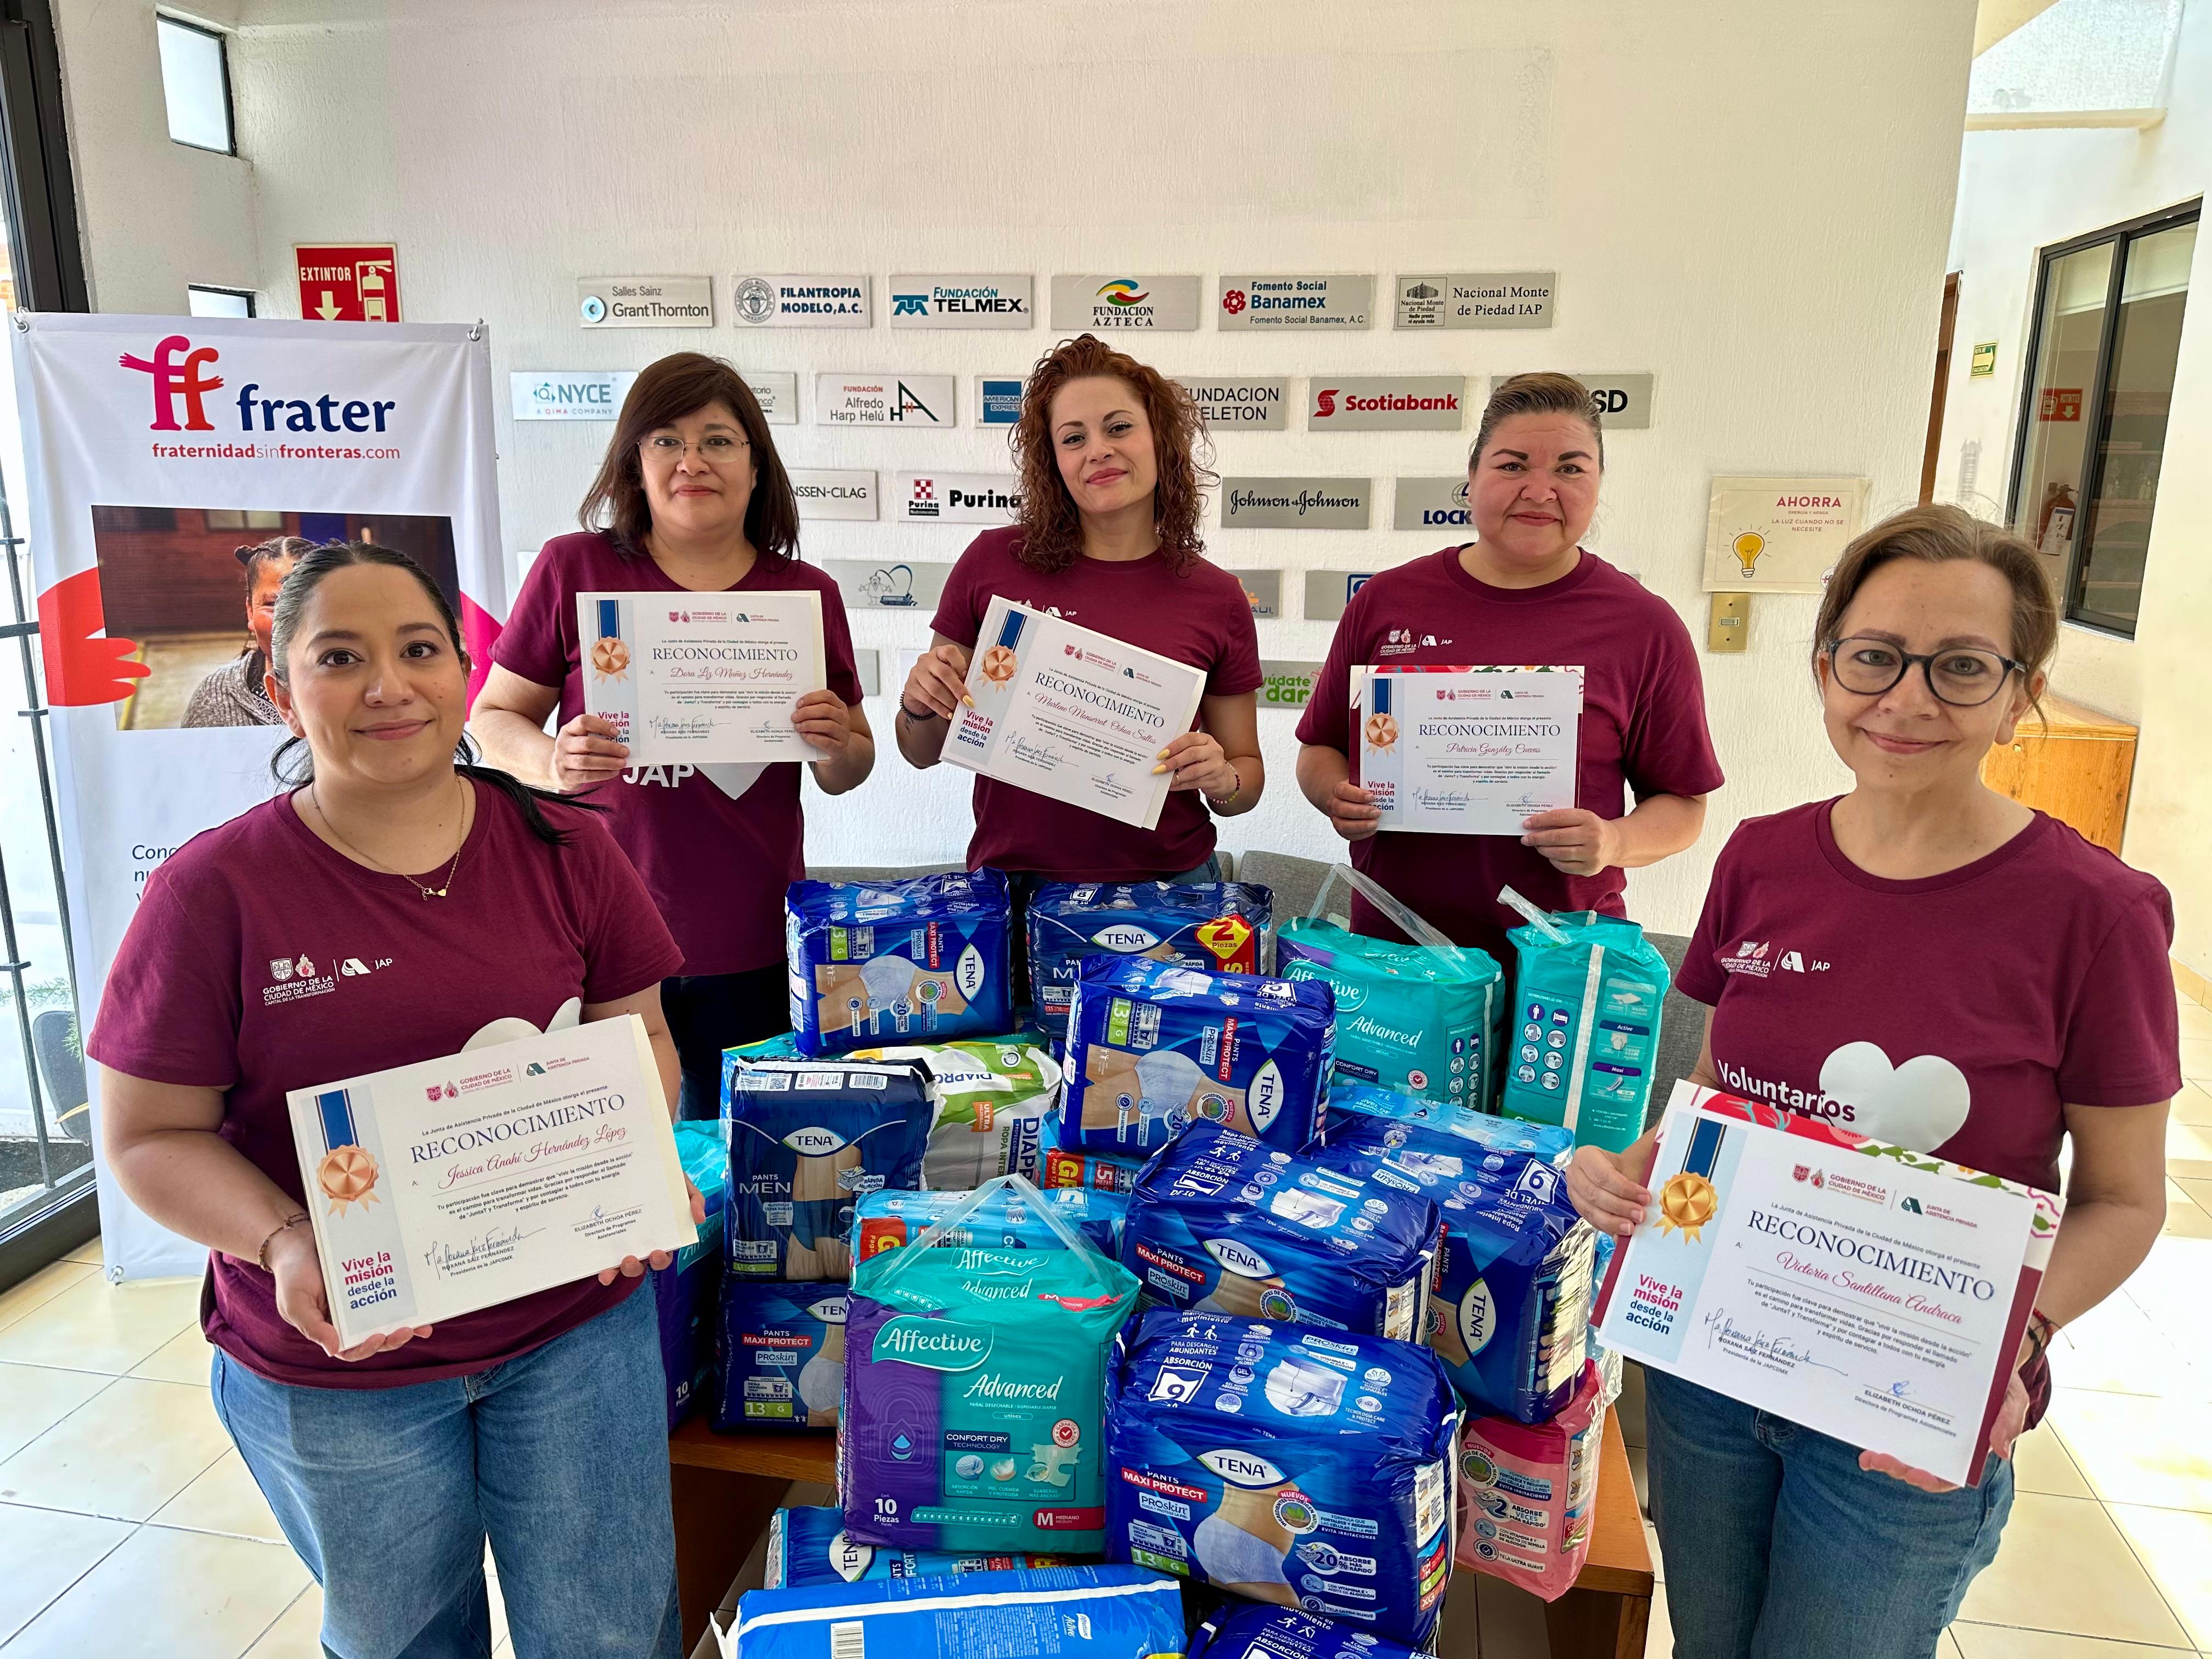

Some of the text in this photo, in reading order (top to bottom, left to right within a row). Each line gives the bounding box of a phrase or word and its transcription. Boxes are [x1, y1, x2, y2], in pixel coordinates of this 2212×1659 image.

[300, 266, 352, 282] EXTINTOR
[612, 286, 662, 296] Salles Sainz
[781, 288, 861, 298] FILANTROPIA
[934, 287, 998, 298] FUNDACIÓN
[1252, 281, 1327, 291] Fomento Social
[1453, 286, 1549, 298] Nacional Monte
[934, 299, 1023, 313] TELMEX
[1251, 295, 1326, 309] Banamex
[1093, 306, 1153, 316] FUNDACION
[1457, 304, 1542, 316] de Piedad IAP
[1093, 317, 1153, 326] AZTECA
[1250, 315, 1365, 325] Fomento Social Banamex, A.C.
[558, 384, 612, 403] NYCE
[843, 385, 883, 393] FUNDACIÓN
[1184, 388, 1279, 402] UNDACION
[236, 383, 396, 432] frater
[845, 397, 884, 409] Alfredo
[1346, 394, 1458, 411] Scotiabank
[1594, 390, 1628, 413] SD
[830, 409, 884, 422] Harp Helú
[1201, 407, 1266, 420] ELETON
[153, 443, 400, 459] fraternidadsinfronteras.com
[793, 486, 867, 498] NSSEN-CILAG
[1231, 490, 1290, 515] Johnson
[1299, 490, 1359, 515] Johnson
[1776, 496, 1841, 507] AHORRA
[1424, 510, 1472, 524] LOCK
[653, 648, 797, 661] RECONOCIMIENTO
[670, 668, 695, 677] Dora
[749, 668, 793, 681] Hernández
[1262, 674, 1311, 689] yúdate
[1035, 672, 1164, 727] RECONOCIMIENTO
[1111, 721, 1131, 735] Ochoa
[1419, 725, 1560, 736] RECONOCIMIENTO
[1446, 743, 1541, 757] Patricia González Cuevas
[623, 763, 695, 788] JAP
[1105, 934, 1143, 944] TENA
[1213, 921, 1234, 942] 2
[375, 958, 393, 970] JAP
[965, 954, 976, 989] TENA
[1811, 960, 1830, 972] JAP
[263, 980, 307, 995] GOBIERNO
[321, 975, 333, 984] LA
[264, 981, 334, 1001] CIUDAD DE MÉXICO
[1347, 1015, 1423, 1047] Advanced
[1257, 1074, 1274, 1117] TENA
[1718, 1059, 1855, 1122] Voluntarios
[410, 1094, 624, 1163] RECONOCIMIENTO
[795, 1136, 833, 1146] TENA
[438, 1124, 627, 1189] Jessica Anahí Hernández López
[739, 1182, 791, 1194] MEN
[1804, 1212, 1832, 1224] Asistencia
[1834, 1221, 1855, 1232] Privada
[1872, 1233, 1892, 1243] Ciudad
[1903, 1242, 1923, 1252] México
[1926, 1250, 1945, 1259] otorga
[1953, 1258, 1980, 1269] presente
[1217, 1243, 1259, 1271] TENA
[1748, 1210, 1994, 1300] RECONOCIMIENTO
[1640, 1274, 1682, 1299] Vive la
[1777, 1252, 1961, 1323] Victoria Santillana Andraca
[1634, 1289, 1681, 1311] misión
[1470, 1294, 1486, 1343] TENA
[1630, 1300, 1673, 1322] desde la
[1626, 1312, 1669, 1334] acción
[881, 1328, 984, 1352] Affective
[1164, 1356, 1212, 1370] ABSORCIÓN
[963, 1374, 1063, 1401] Advanced
[946, 1433, 984, 1442] CONFORT
[1214, 1457, 1266, 1479] TENA
[1124, 1471, 1204, 1500] MAXI PROTECT
[1142, 1495, 1188, 1513] PROskin
[1282, 1492, 1308, 1502] NUEVOS
[875, 1498, 897, 1514] 10
[874, 1515, 899, 1524] Piezas
[1037, 1513, 1053, 1526] M
[1315, 1551, 1372, 1566] 20 ABSORBE
